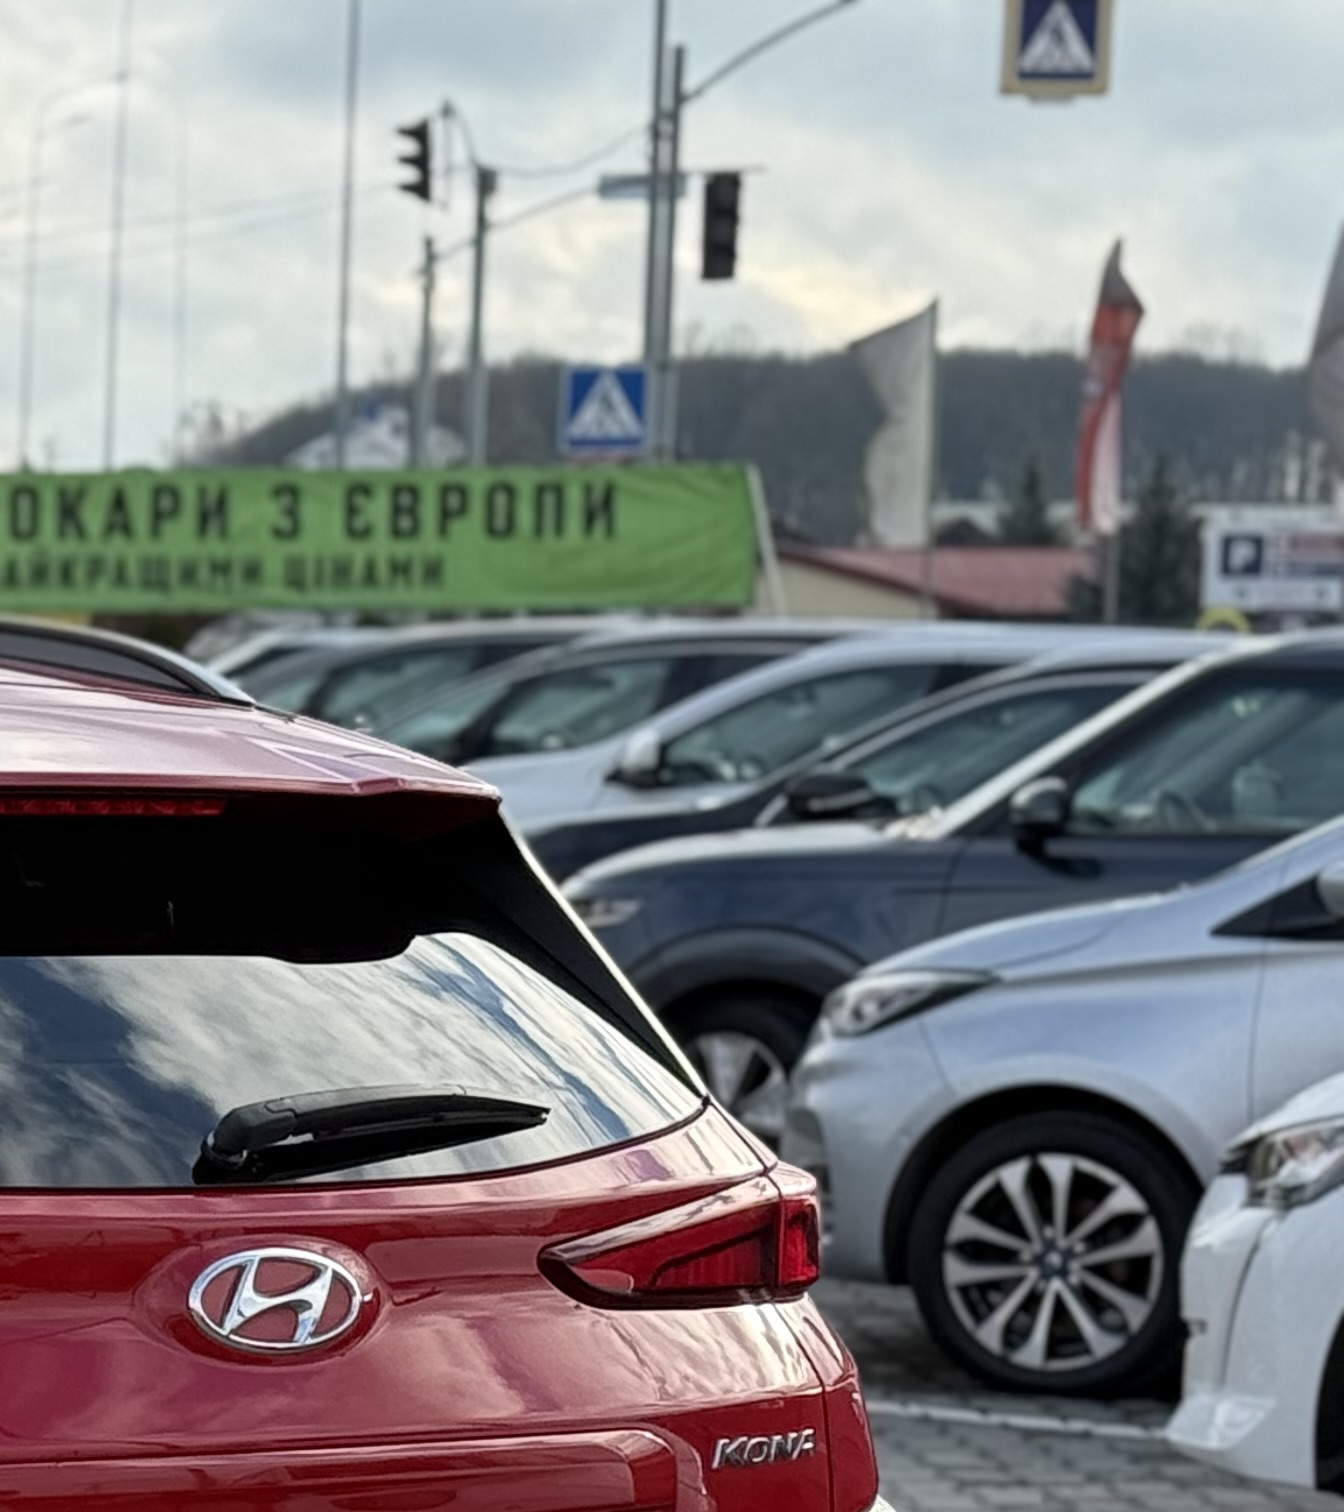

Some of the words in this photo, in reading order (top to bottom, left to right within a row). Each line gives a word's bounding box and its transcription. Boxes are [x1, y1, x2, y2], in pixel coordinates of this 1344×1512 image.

[270, 483, 302, 541] З
[344, 483, 617, 541] ЄВРОПИ
[282, 553, 445, 593] ЦІНАМИ
[711, 1428, 815, 1470] KONA
